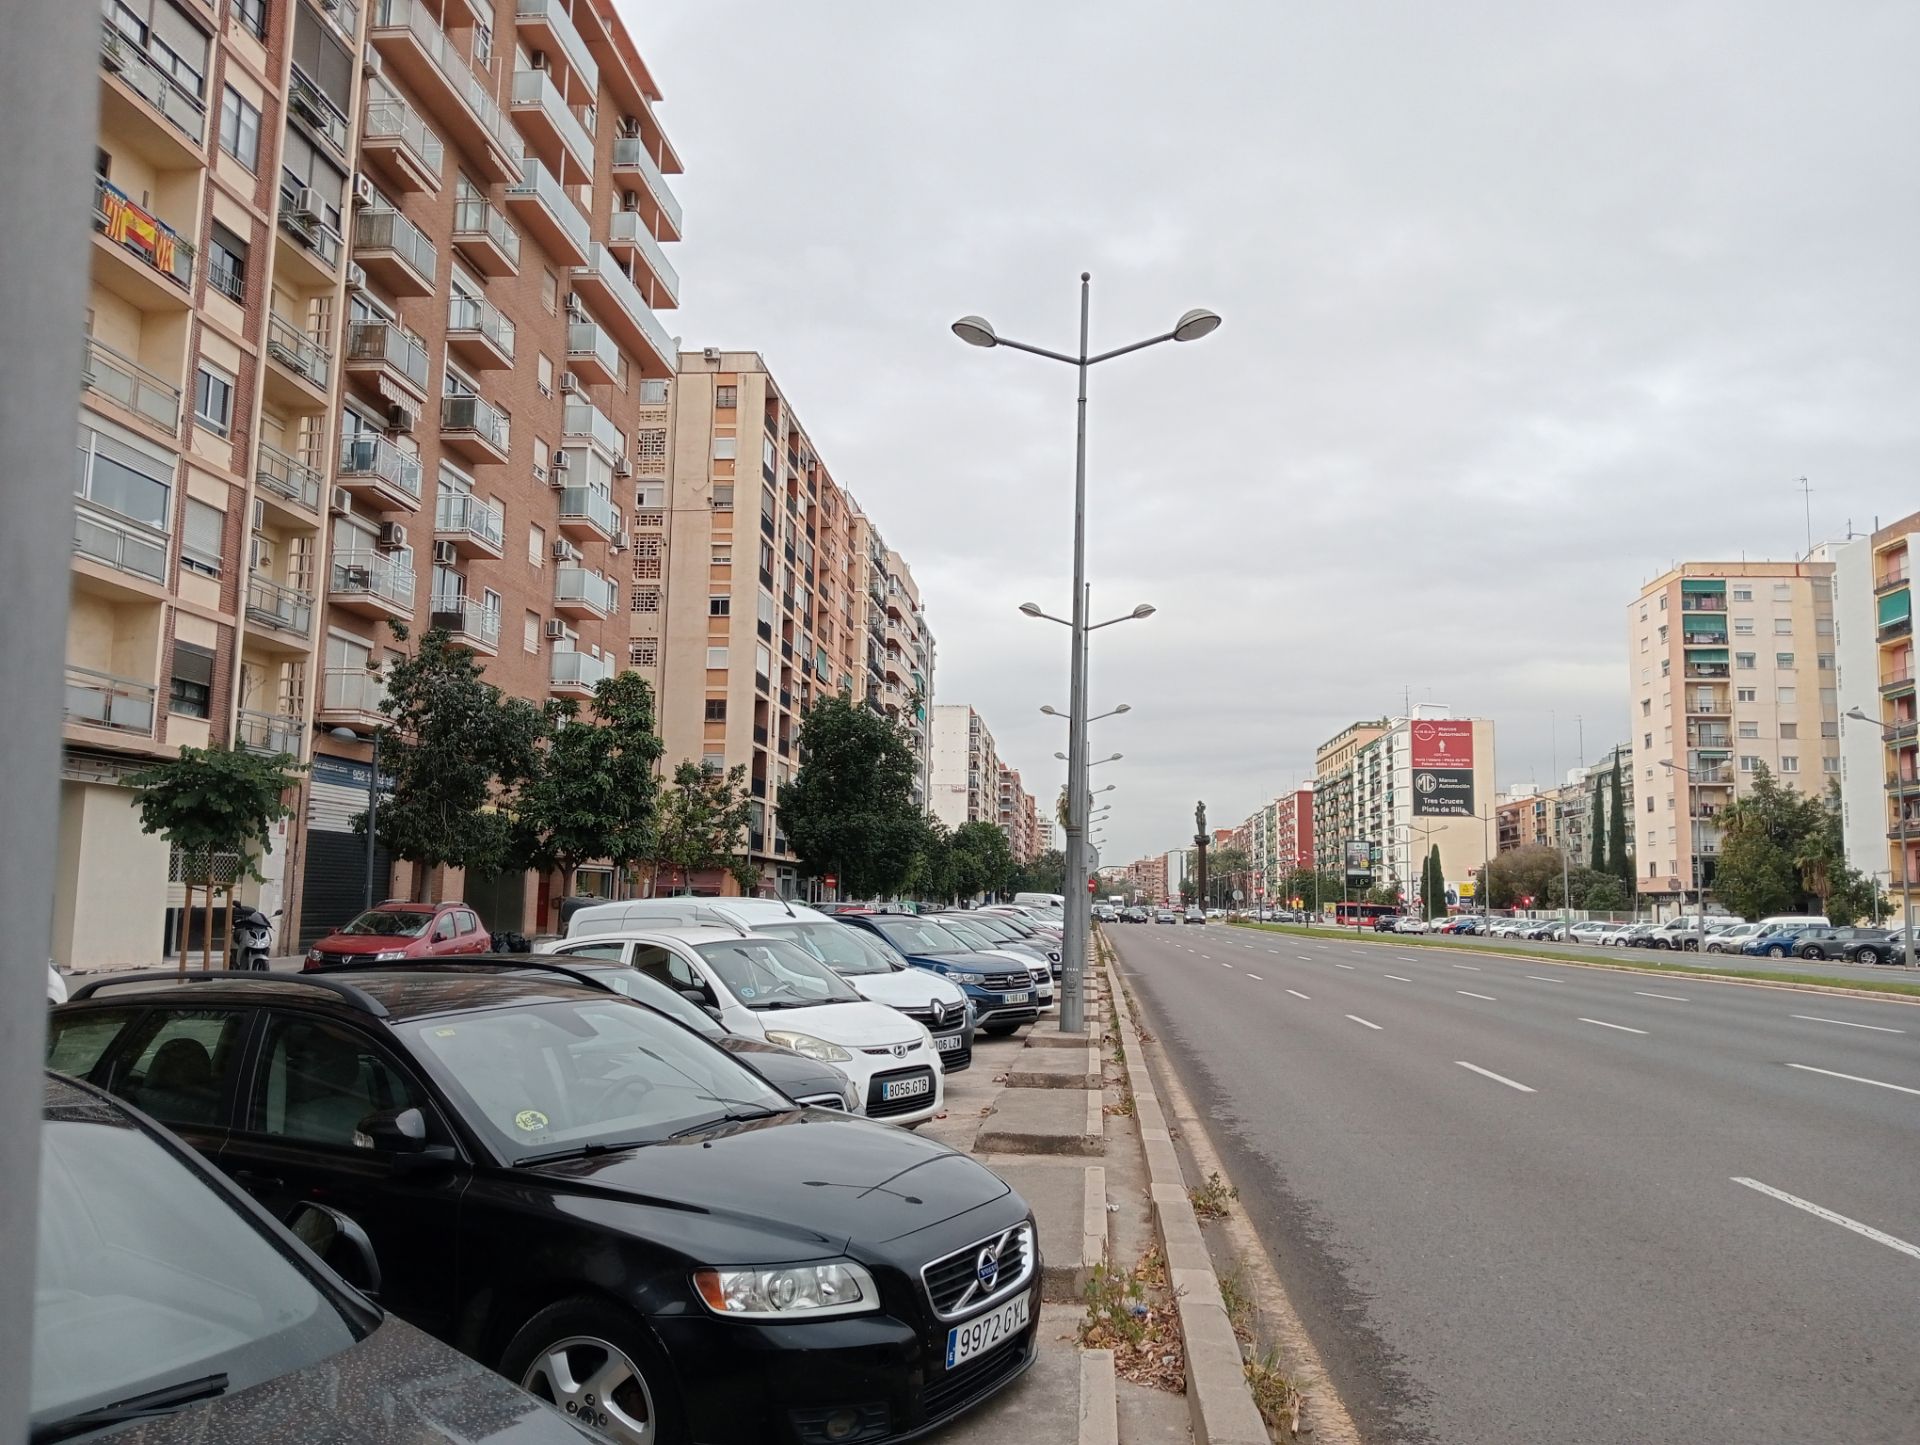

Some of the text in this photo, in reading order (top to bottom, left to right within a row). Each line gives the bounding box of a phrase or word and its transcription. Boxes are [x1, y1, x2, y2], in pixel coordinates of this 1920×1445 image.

[1417, 775, 1436, 792] MG
[1422, 797, 1464, 805] Tres Cruces
[889, 1078, 927, 1097] 8056 GTB
[960, 1298, 1027, 1357] 9972 GYL
